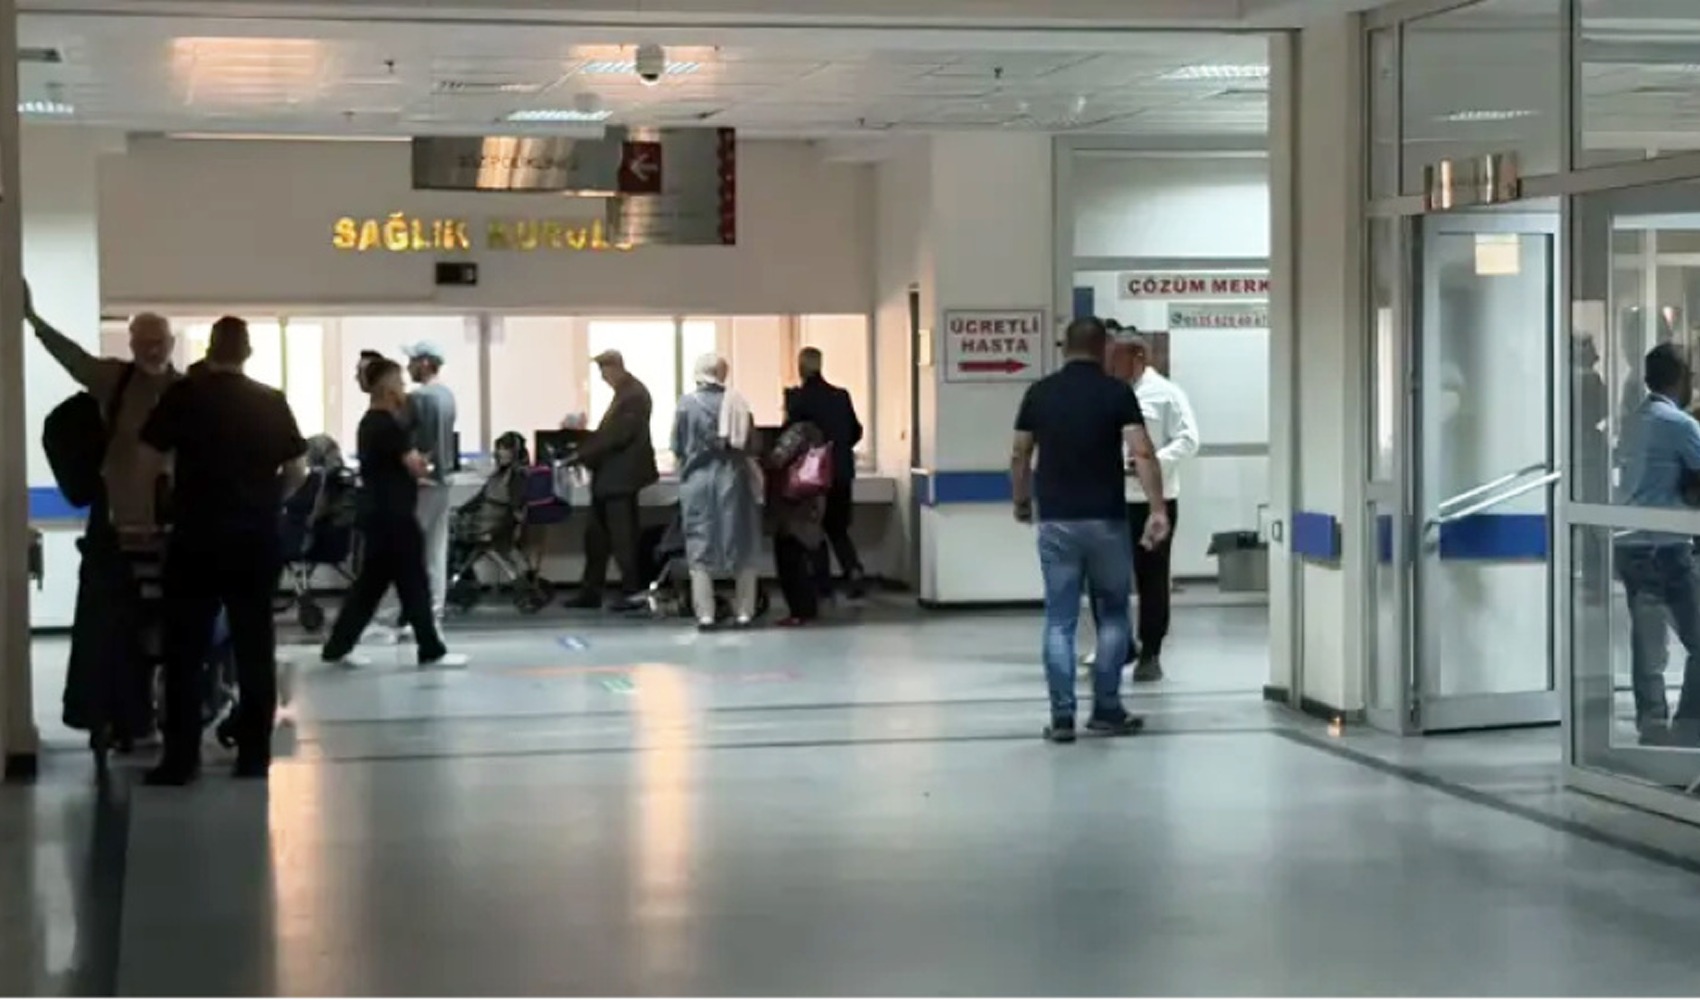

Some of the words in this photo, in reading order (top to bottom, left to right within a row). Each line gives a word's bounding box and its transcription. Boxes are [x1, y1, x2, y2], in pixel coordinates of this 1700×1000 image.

[333, 211, 470, 250] SAĞLIK
[487, 217, 634, 251] KURUL
[1128, 275, 1205, 295] ÇÖZÜM
[950, 315, 1039, 335] ÜCRETLİ
[961, 337, 1029, 353] HASTA
